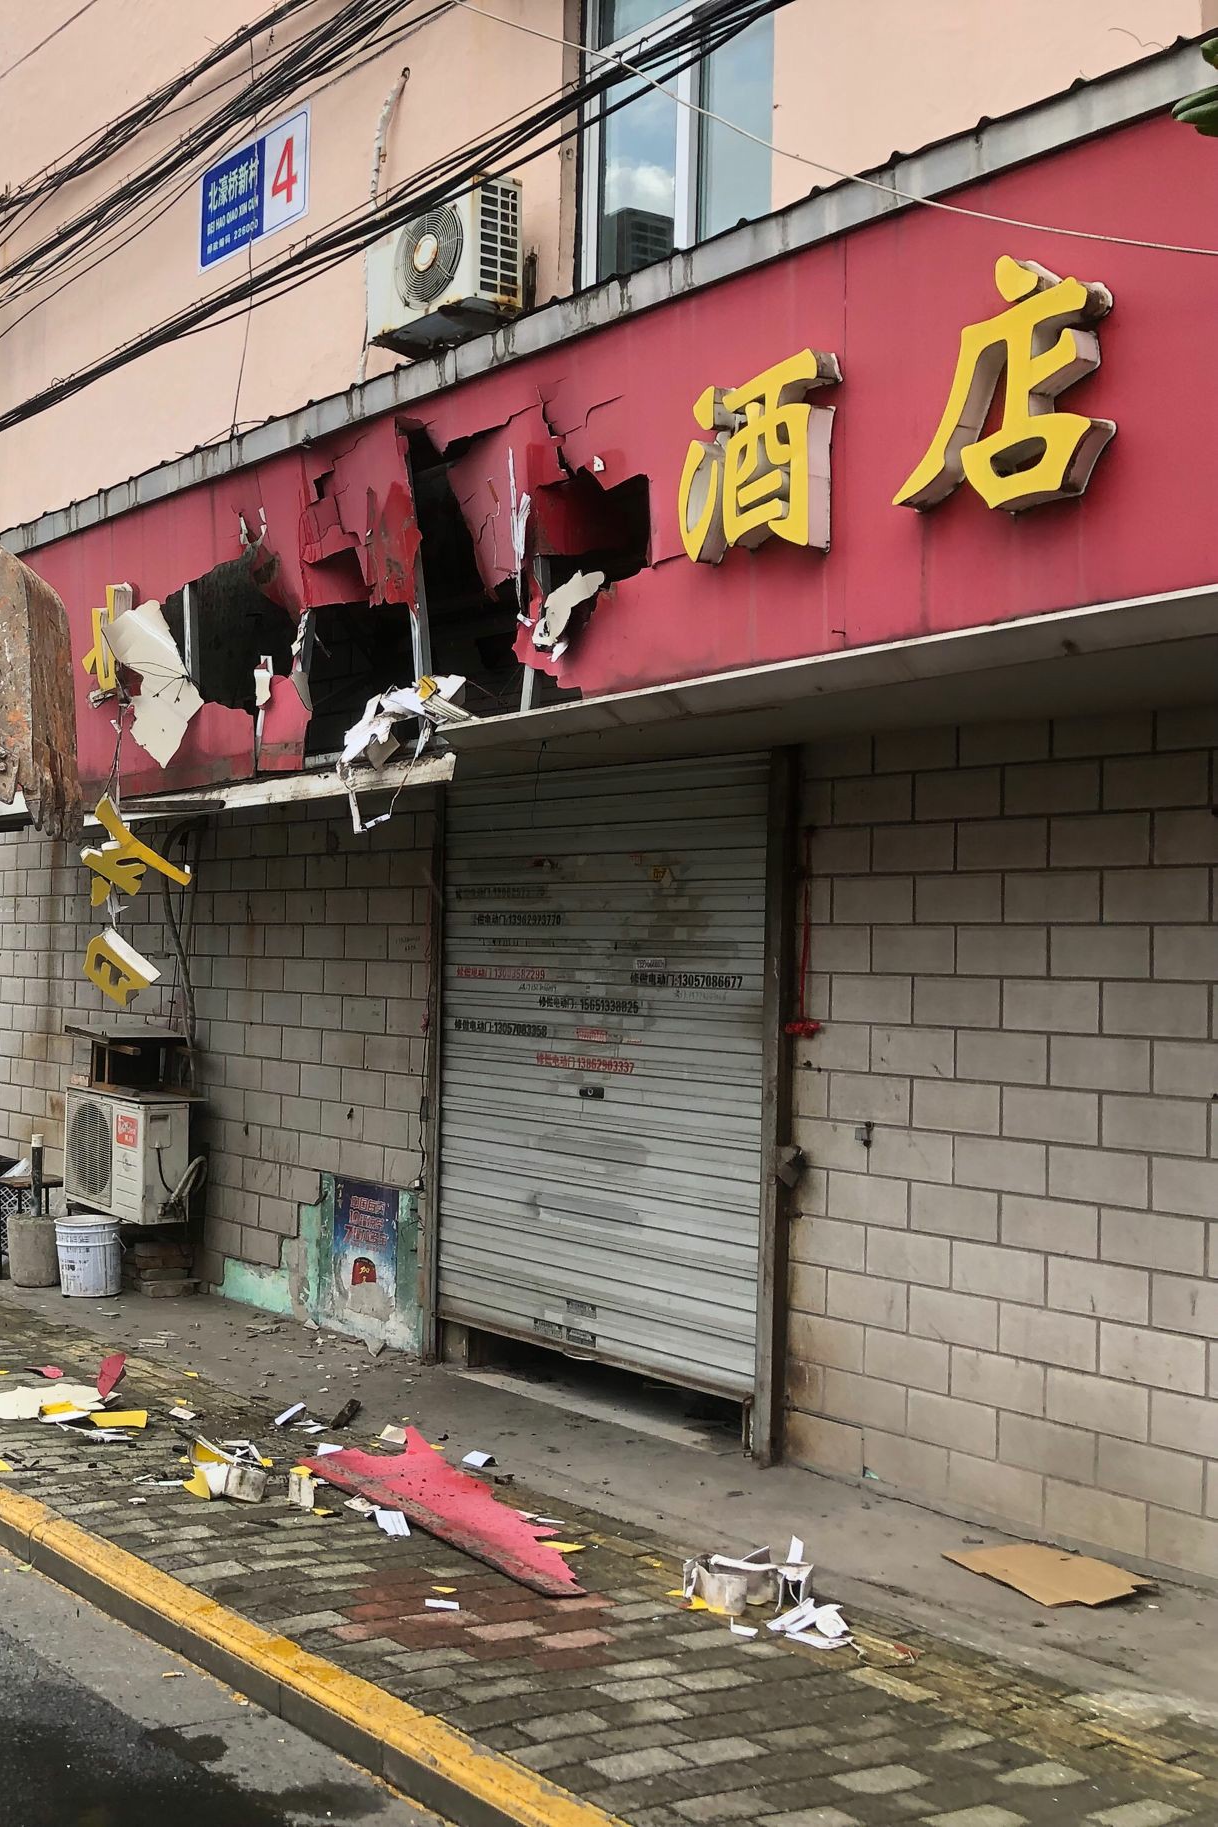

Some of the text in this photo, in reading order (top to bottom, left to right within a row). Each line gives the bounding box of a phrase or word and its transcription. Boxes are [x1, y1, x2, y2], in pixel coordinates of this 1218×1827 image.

[208, 157, 260, 212] 北濠桥新村
[271, 135, 298, 204] 4
[215, 215, 226, 230] HAO
[678, 254, 1092, 562] 酒店
